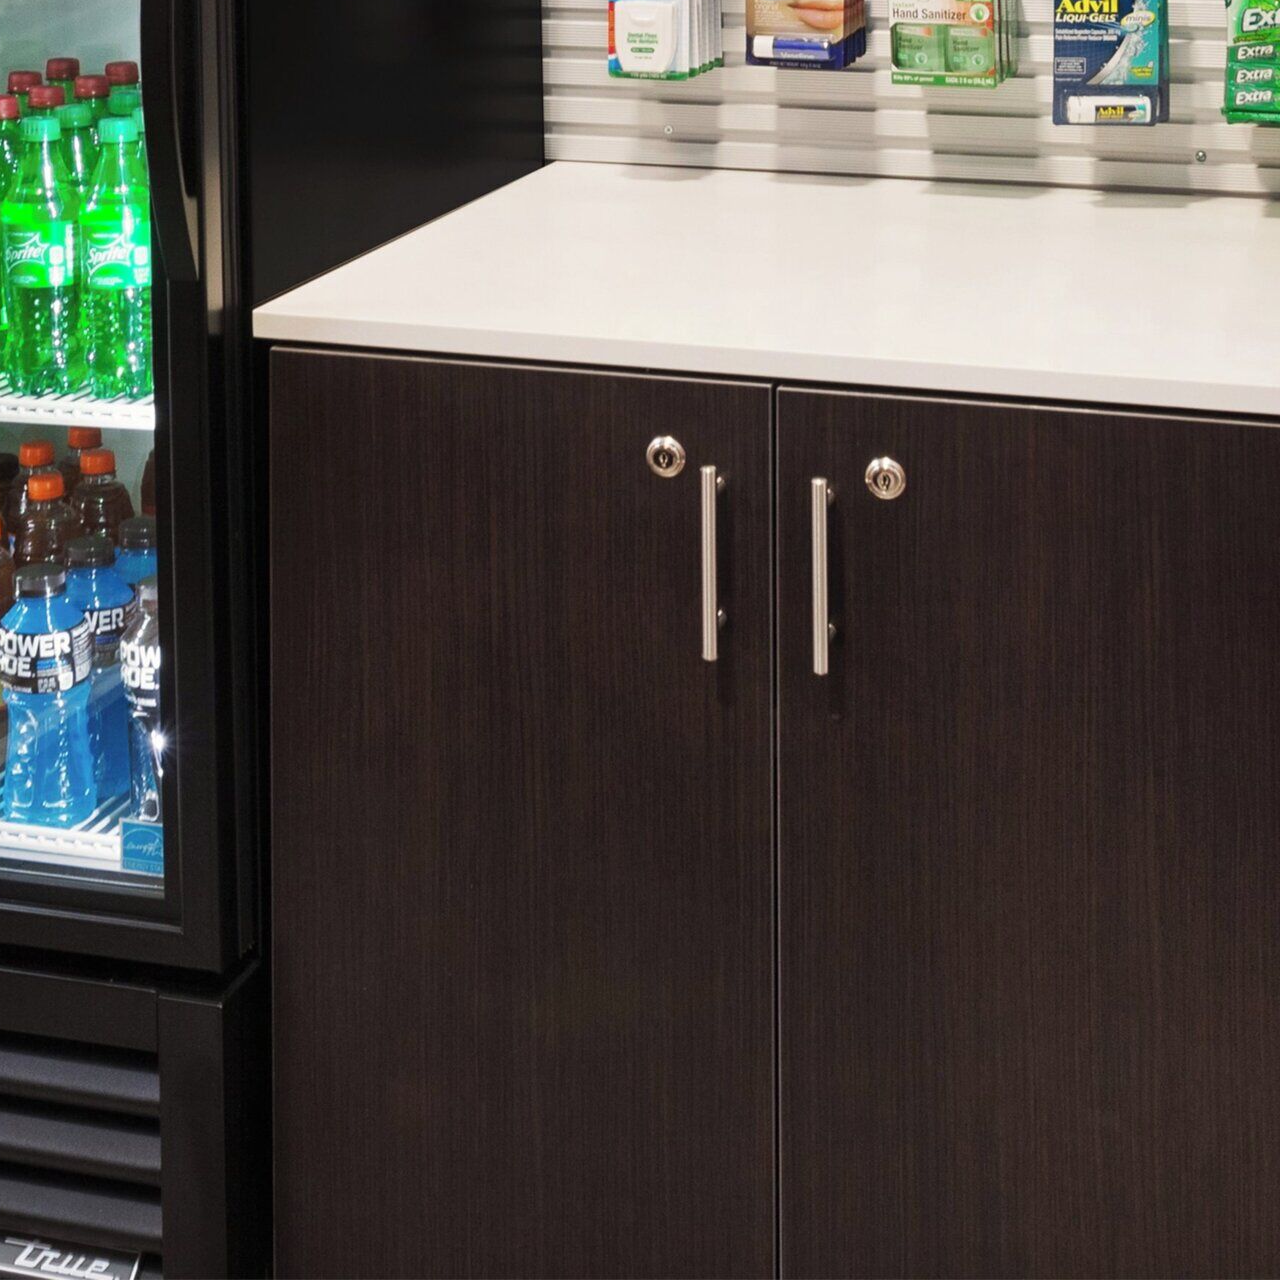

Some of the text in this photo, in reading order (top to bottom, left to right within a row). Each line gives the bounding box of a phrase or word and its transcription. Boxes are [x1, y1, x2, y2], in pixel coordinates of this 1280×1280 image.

[892, 8, 966, 21] Hand Sanitizer
[1056, 13, 1117, 23] LIQUI-GELS
[1238, 45, 1274, 60] Extra
[1236, 69, 1273, 83] Extra
[1235, 91, 1272, 105] Extra
